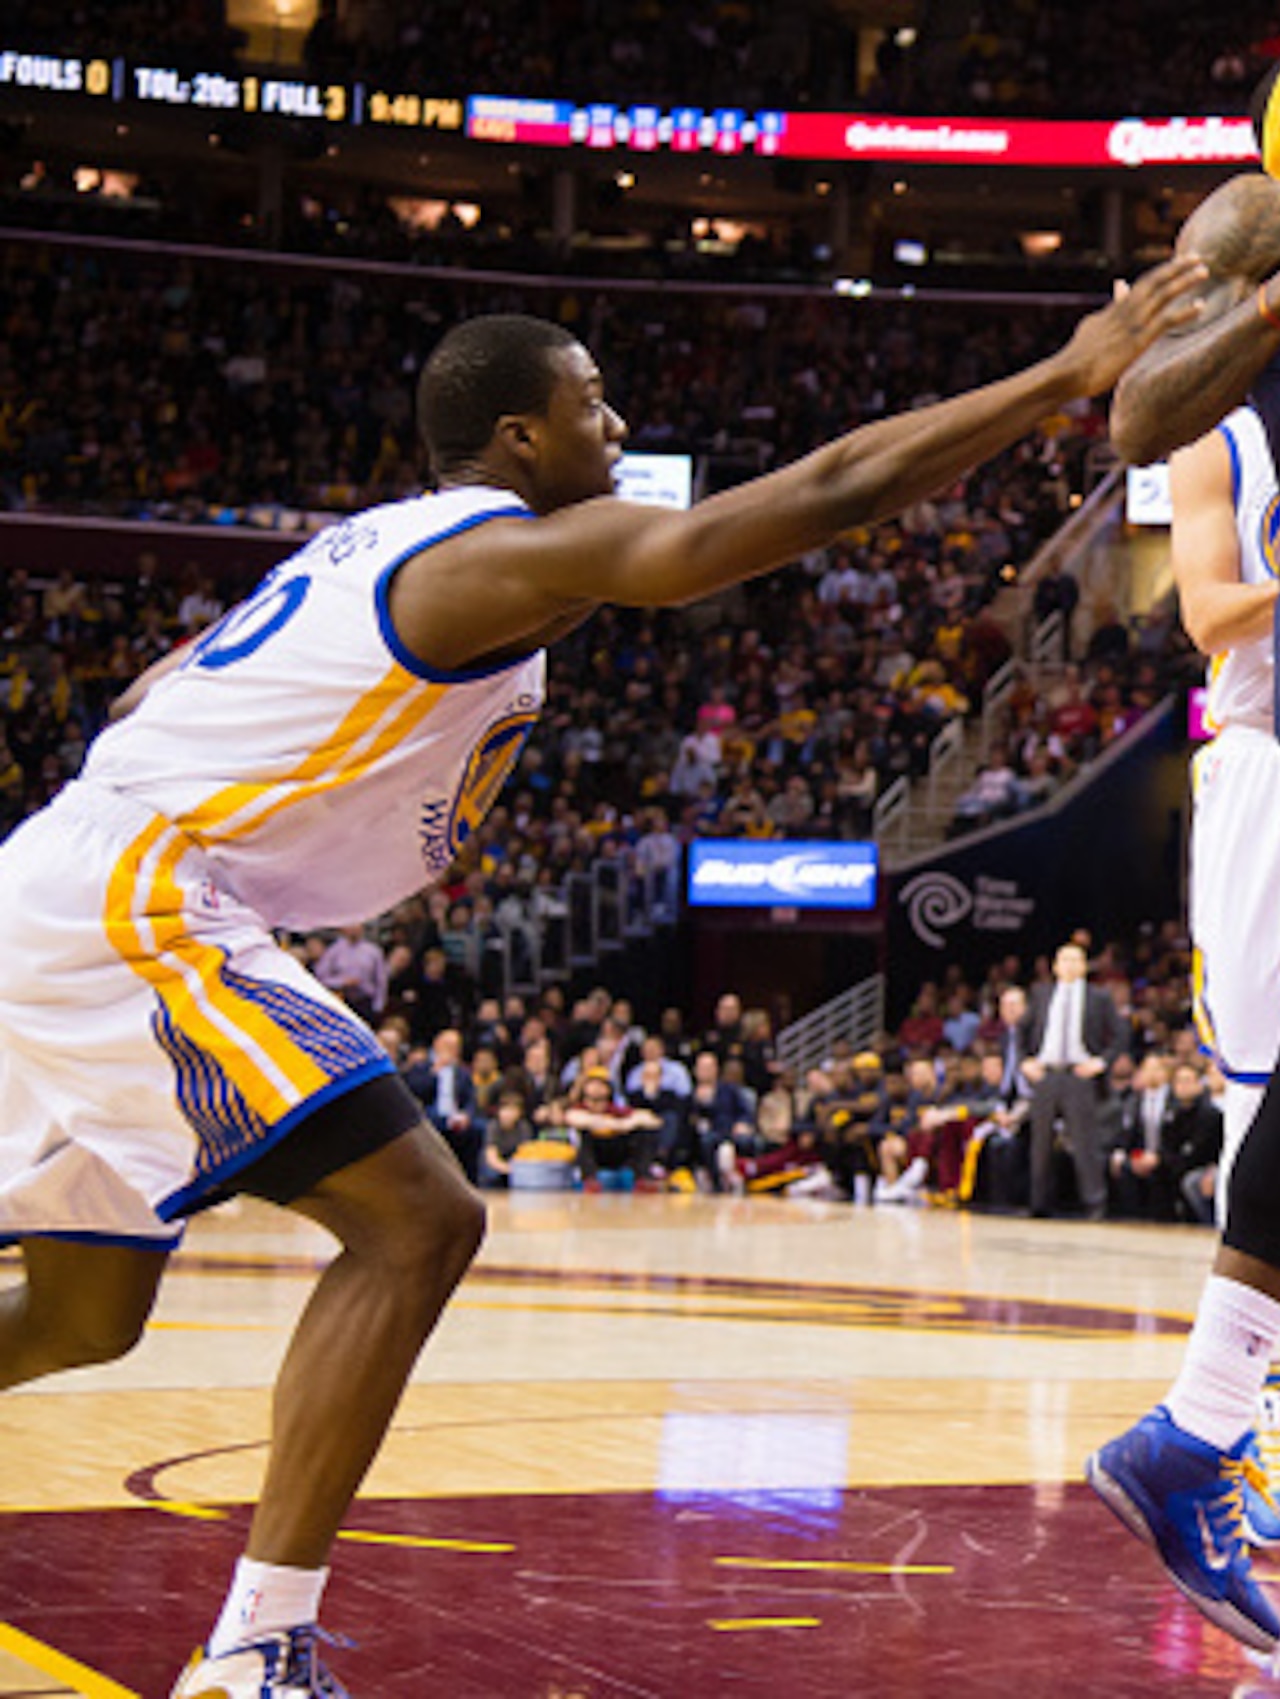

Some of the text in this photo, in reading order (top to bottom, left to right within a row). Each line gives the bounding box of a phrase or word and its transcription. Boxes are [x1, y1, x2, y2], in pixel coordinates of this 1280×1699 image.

[0, 51, 109, 95] FOULS 0
[242, 76, 258, 112] 1
[261, 80, 323, 117] FULL
[324, 85, 346, 121] 3
[422, 98, 464, 130] PM
